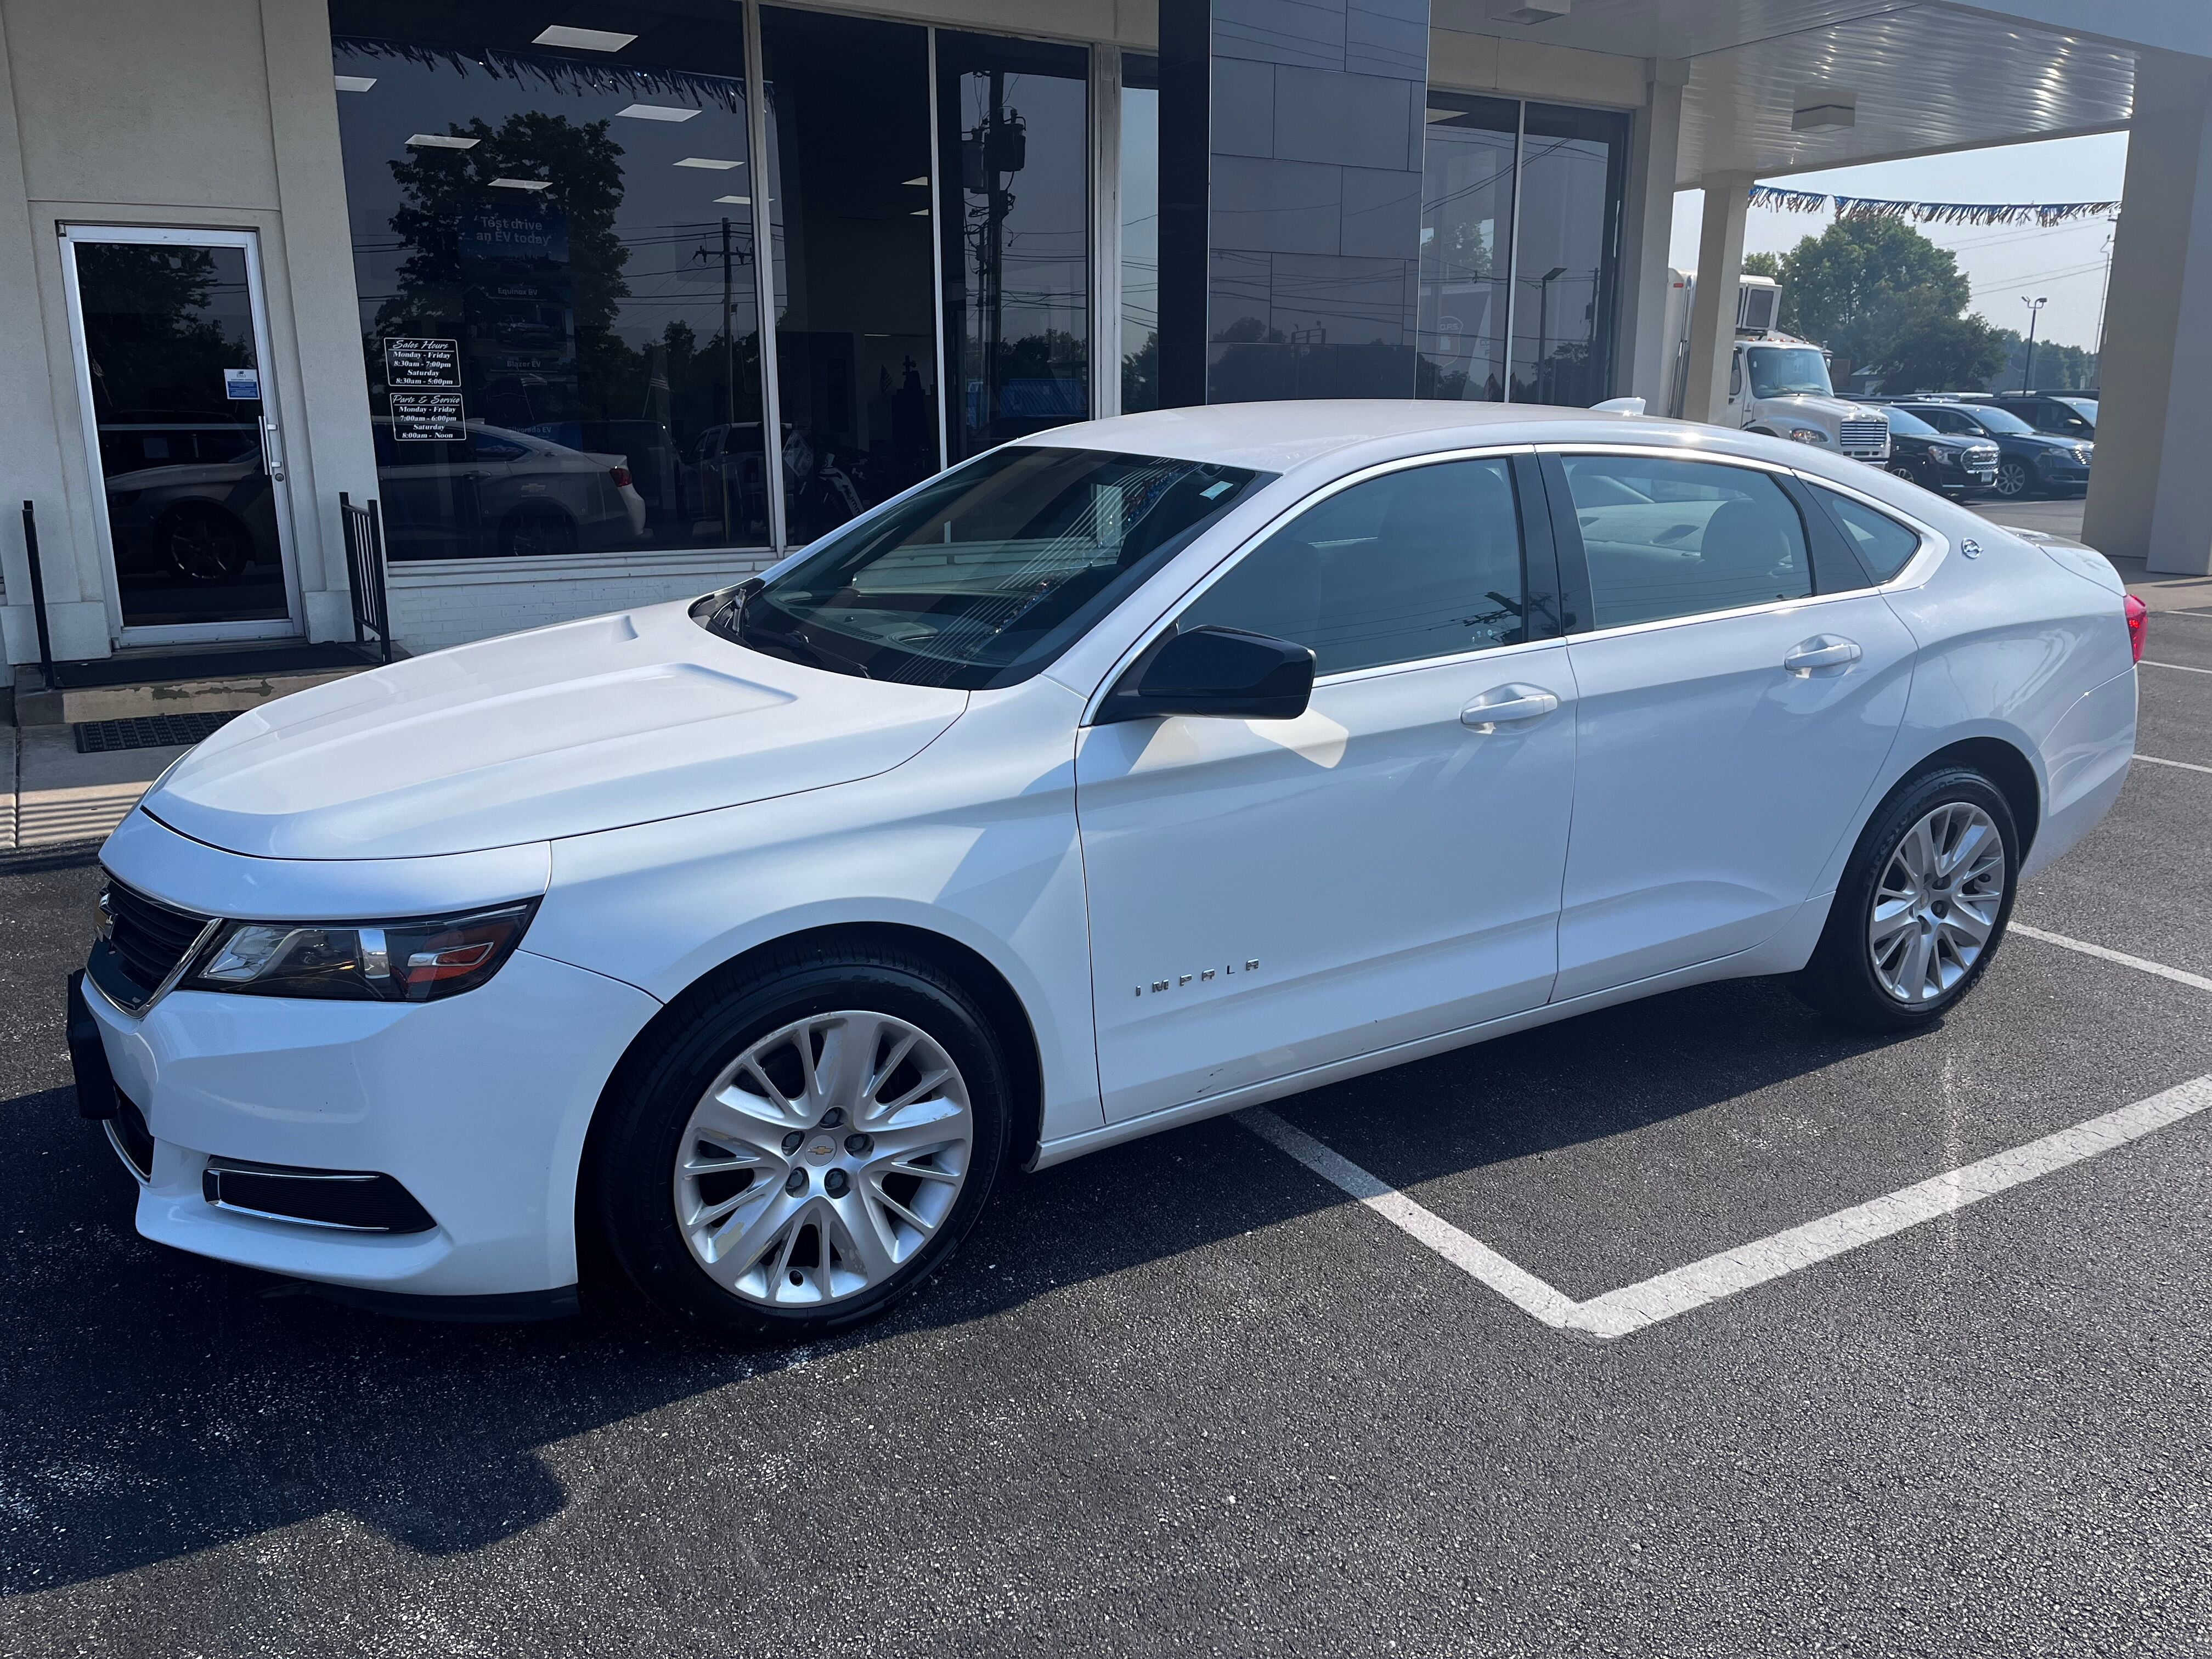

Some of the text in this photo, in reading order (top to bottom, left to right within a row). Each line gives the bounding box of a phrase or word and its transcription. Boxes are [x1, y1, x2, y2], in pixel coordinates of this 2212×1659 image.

[480, 216, 543, 230] Test drive
[476, 232, 550, 246] an EV today
[498, 287, 527, 296] Equinox
[392, 340, 449, 349] Sales Hours
[393, 394, 460, 404] Parts & Service
[1136, 958, 1259, 997] IMPALA
